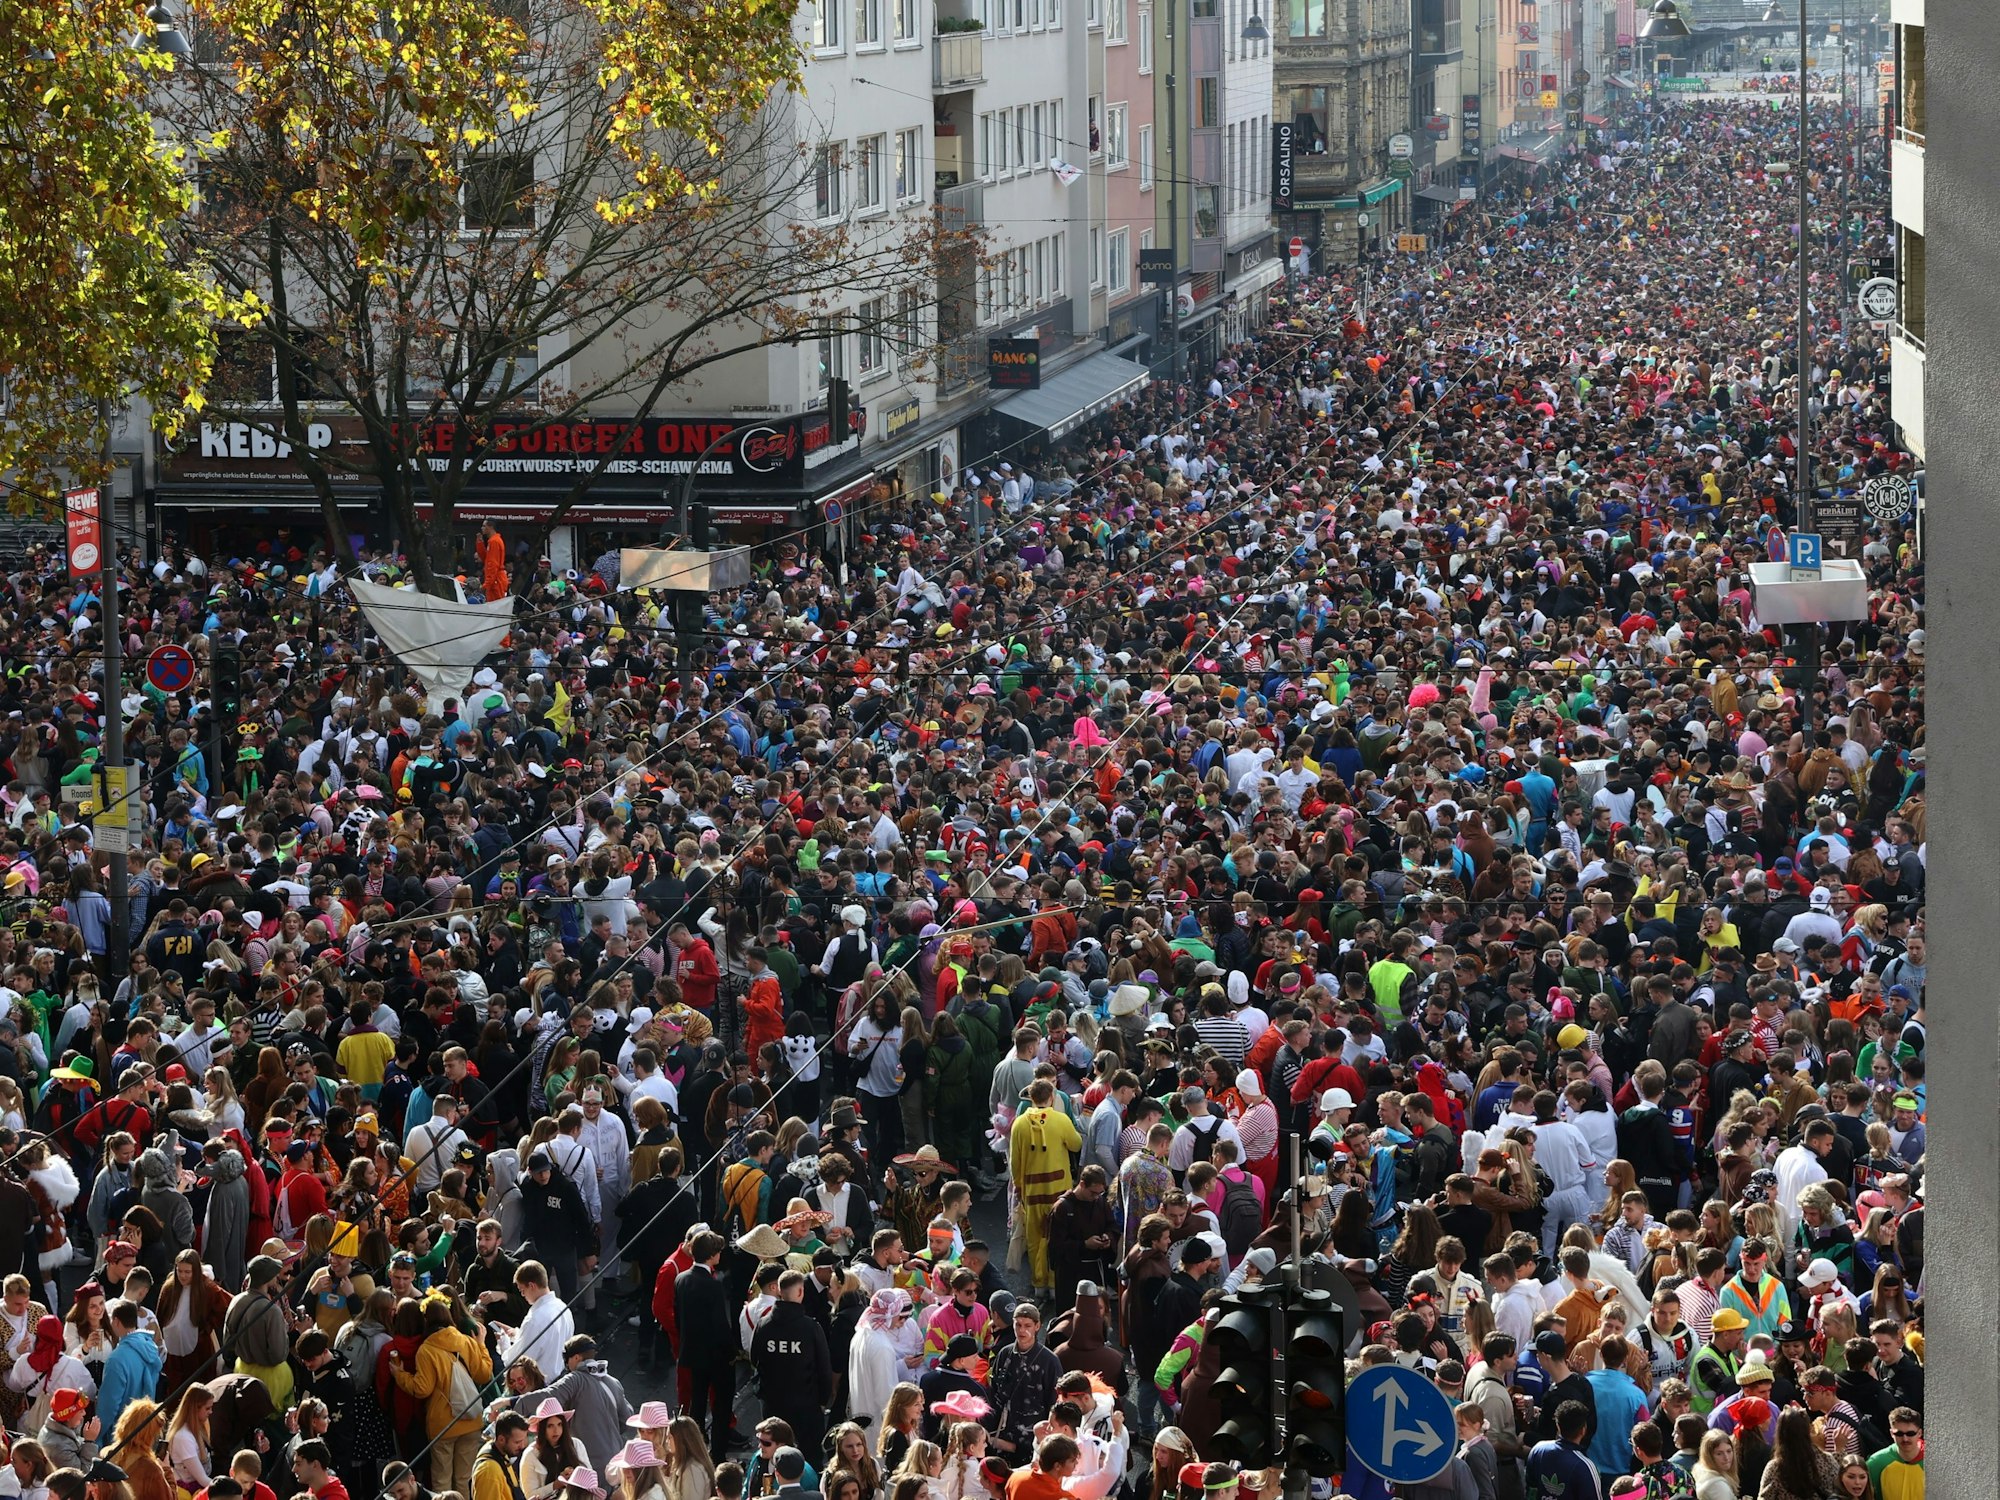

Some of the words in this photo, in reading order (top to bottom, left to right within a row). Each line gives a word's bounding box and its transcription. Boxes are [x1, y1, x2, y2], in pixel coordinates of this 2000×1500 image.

[1141, 261, 1171, 270] duma
[494, 424, 644, 453] BURGER
[658, 425, 734, 454] ONE
[1868, 477, 1907, 494] FRISEUR
[67, 492, 97, 512] REWE
[1879, 491, 1896, 506] K&B
[1868, 501, 1907, 518] 9383320
[1797, 539, 1813, 563] P
[164, 936, 192, 955] FBI
[1672, 1109, 1684, 1124] 9
[547, 1196, 562, 1209] SEK
[767, 1340, 802, 1354] SEK
